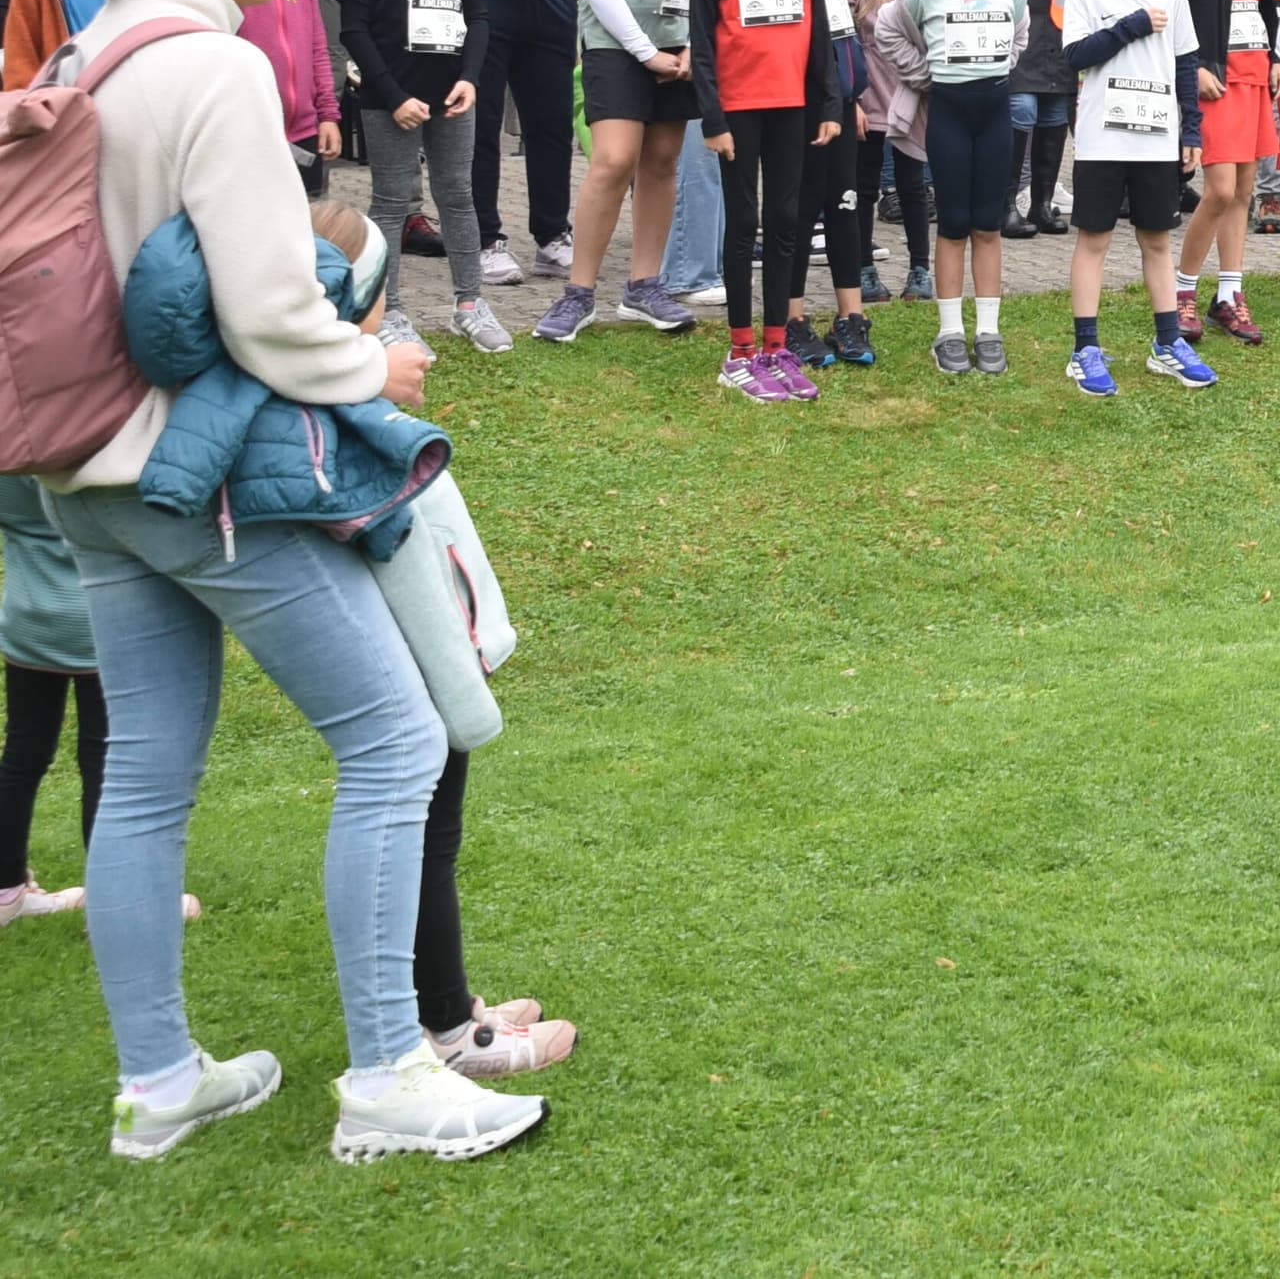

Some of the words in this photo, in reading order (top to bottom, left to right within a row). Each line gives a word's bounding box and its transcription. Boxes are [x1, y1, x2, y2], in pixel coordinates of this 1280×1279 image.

[952, 11, 988, 22] KIMLEMAN
[978, 36, 987, 48] 12
[1137, 105, 1147, 117] 15
